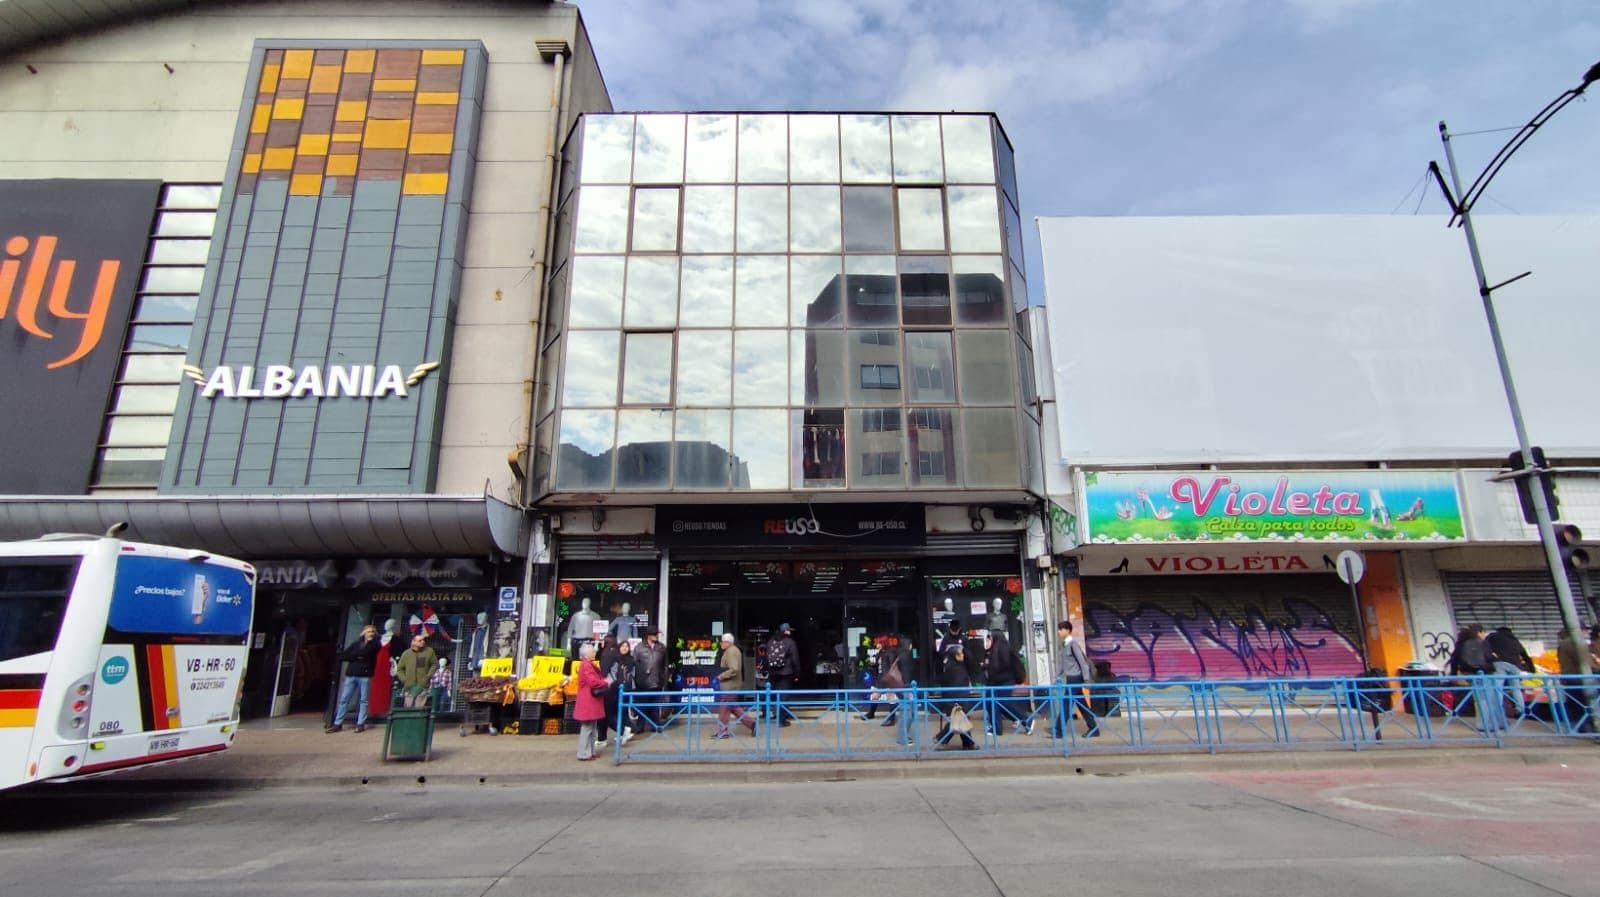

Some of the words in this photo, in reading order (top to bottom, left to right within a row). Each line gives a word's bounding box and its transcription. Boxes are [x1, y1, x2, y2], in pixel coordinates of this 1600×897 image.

[201, 365, 408, 398] ALBANIA
[1169, 475, 1365, 517] Violeta
[1205, 517, 1256, 534] Calza
[1261, 521, 1304, 537] para
[1309, 517, 1356, 532] todos
[1146, 555, 1310, 572] VIOLETA
[256, 566, 319, 585] ANIA
[372, 591, 415, 602] OFERTAS
[417, 591, 450, 602] HASTA
